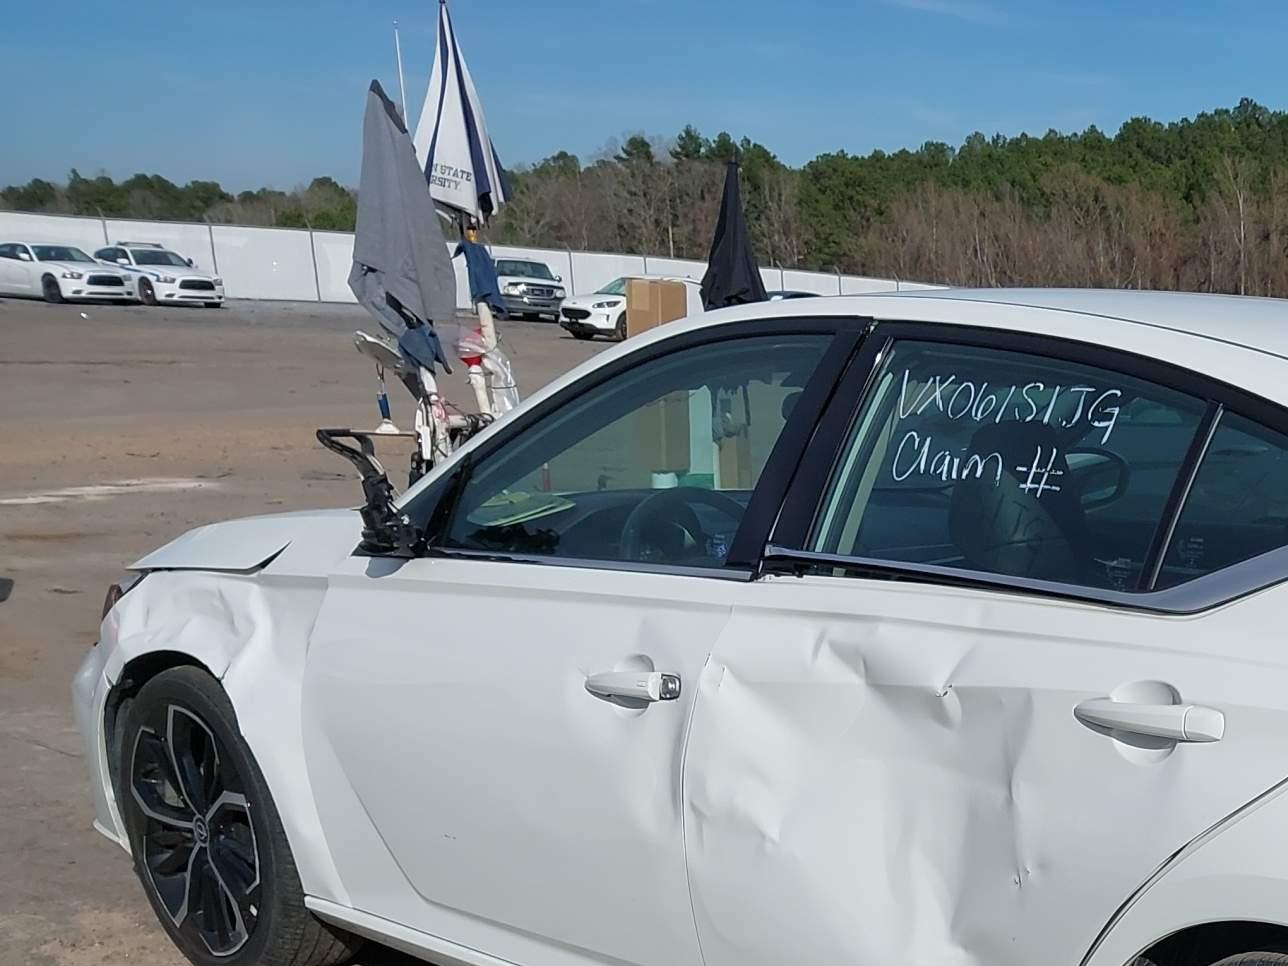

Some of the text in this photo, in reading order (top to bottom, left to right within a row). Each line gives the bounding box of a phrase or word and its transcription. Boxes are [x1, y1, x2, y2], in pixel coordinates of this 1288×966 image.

[440, 165, 472, 182] STATE
[892, 431, 1064, 498] Claim #
